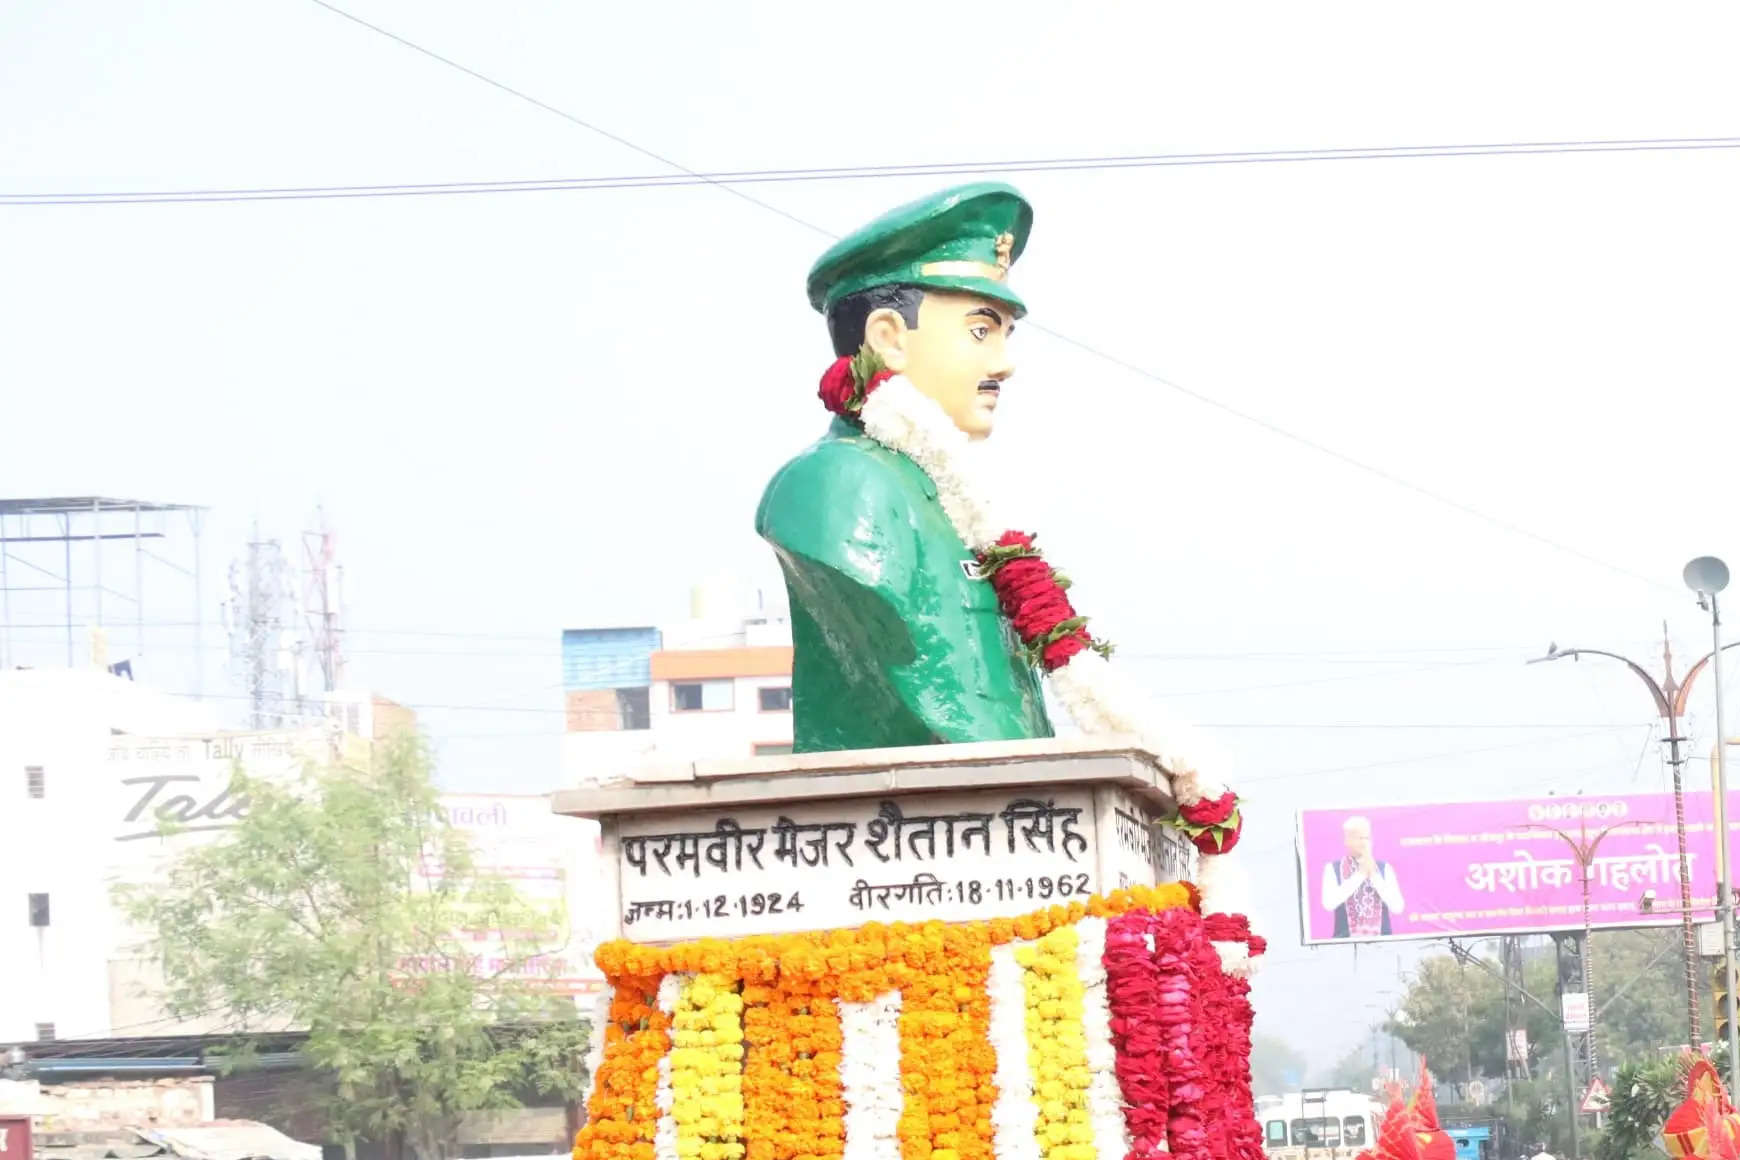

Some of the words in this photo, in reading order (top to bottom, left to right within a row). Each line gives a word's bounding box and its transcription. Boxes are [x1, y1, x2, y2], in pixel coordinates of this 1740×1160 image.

[203, 739, 244, 763] Tally
[622, 816, 768, 878] परमवीर
[864, 800, 995, 864] शैतान
[999, 798, 1087, 862] सिंह
[1465, 850, 1575, 893] अशोक
